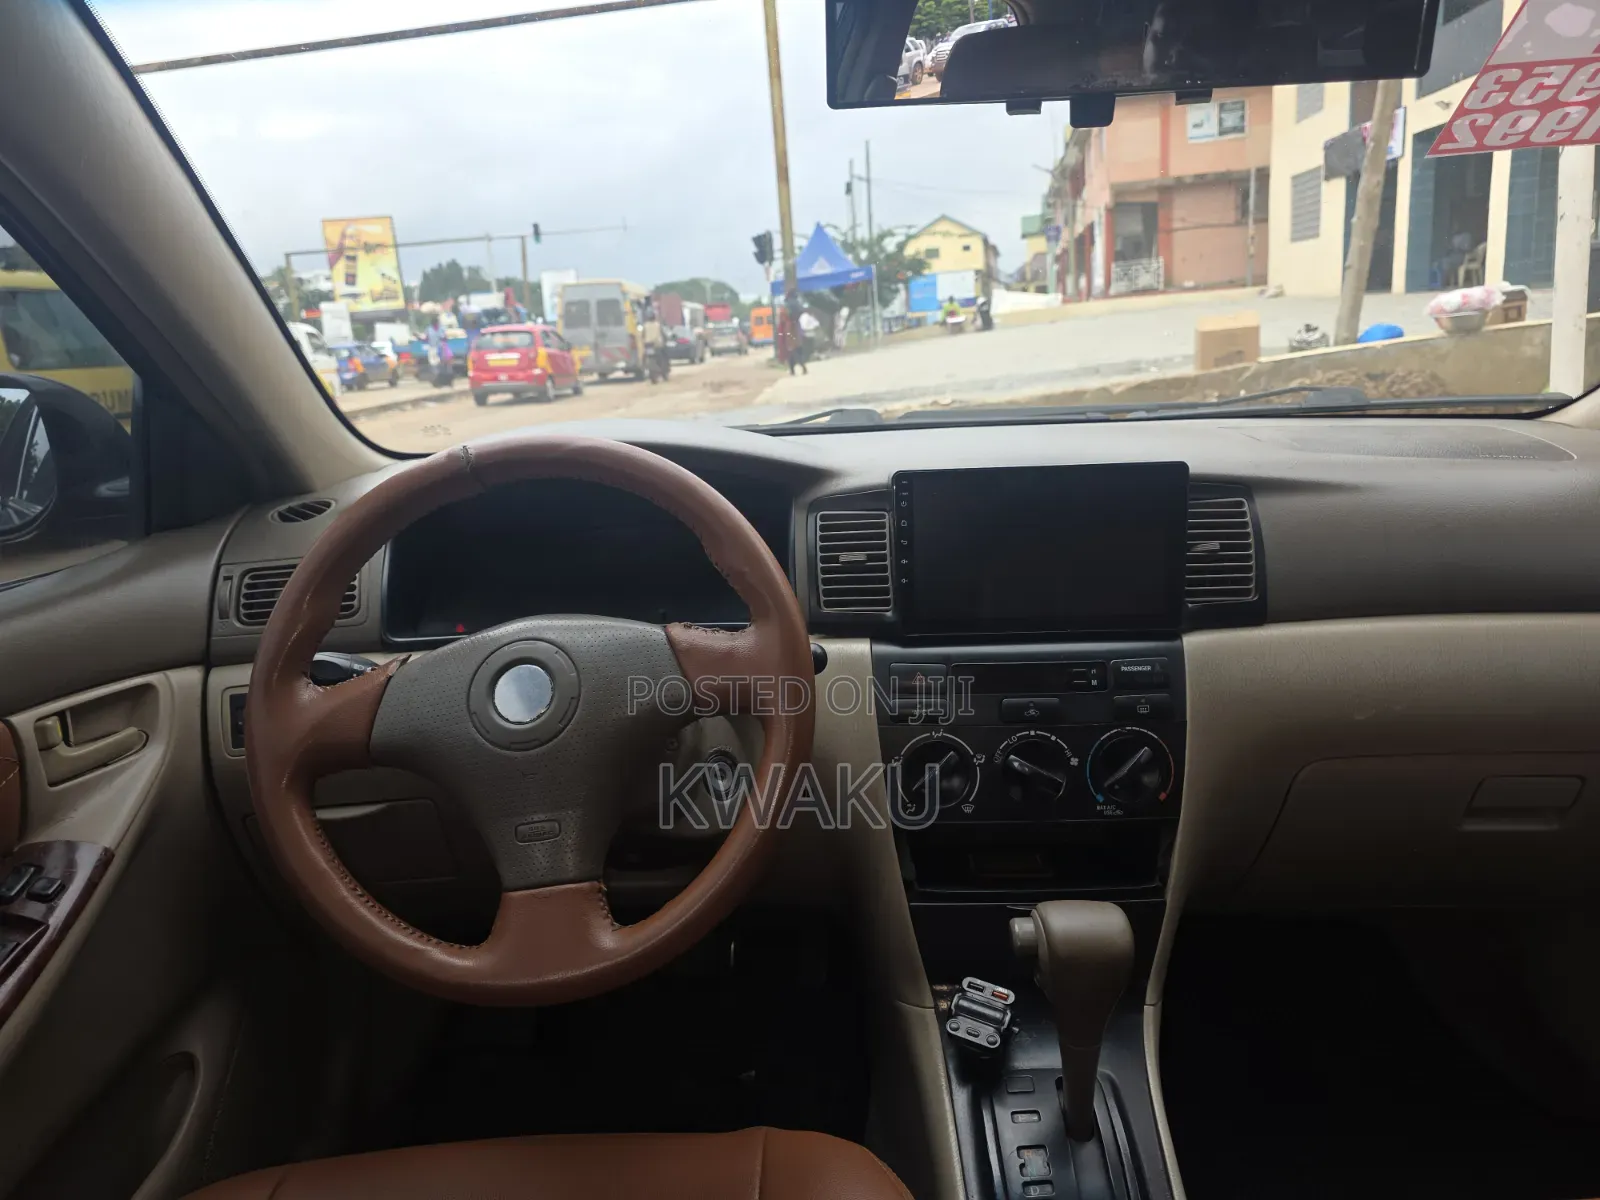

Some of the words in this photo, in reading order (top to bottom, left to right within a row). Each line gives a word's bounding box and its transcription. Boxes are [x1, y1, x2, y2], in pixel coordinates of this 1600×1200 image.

[1120, 664, 1152, 672] PASSENGER
[1007, 735, 1018, 745] LO
[993, 749, 1003, 764] OFF
